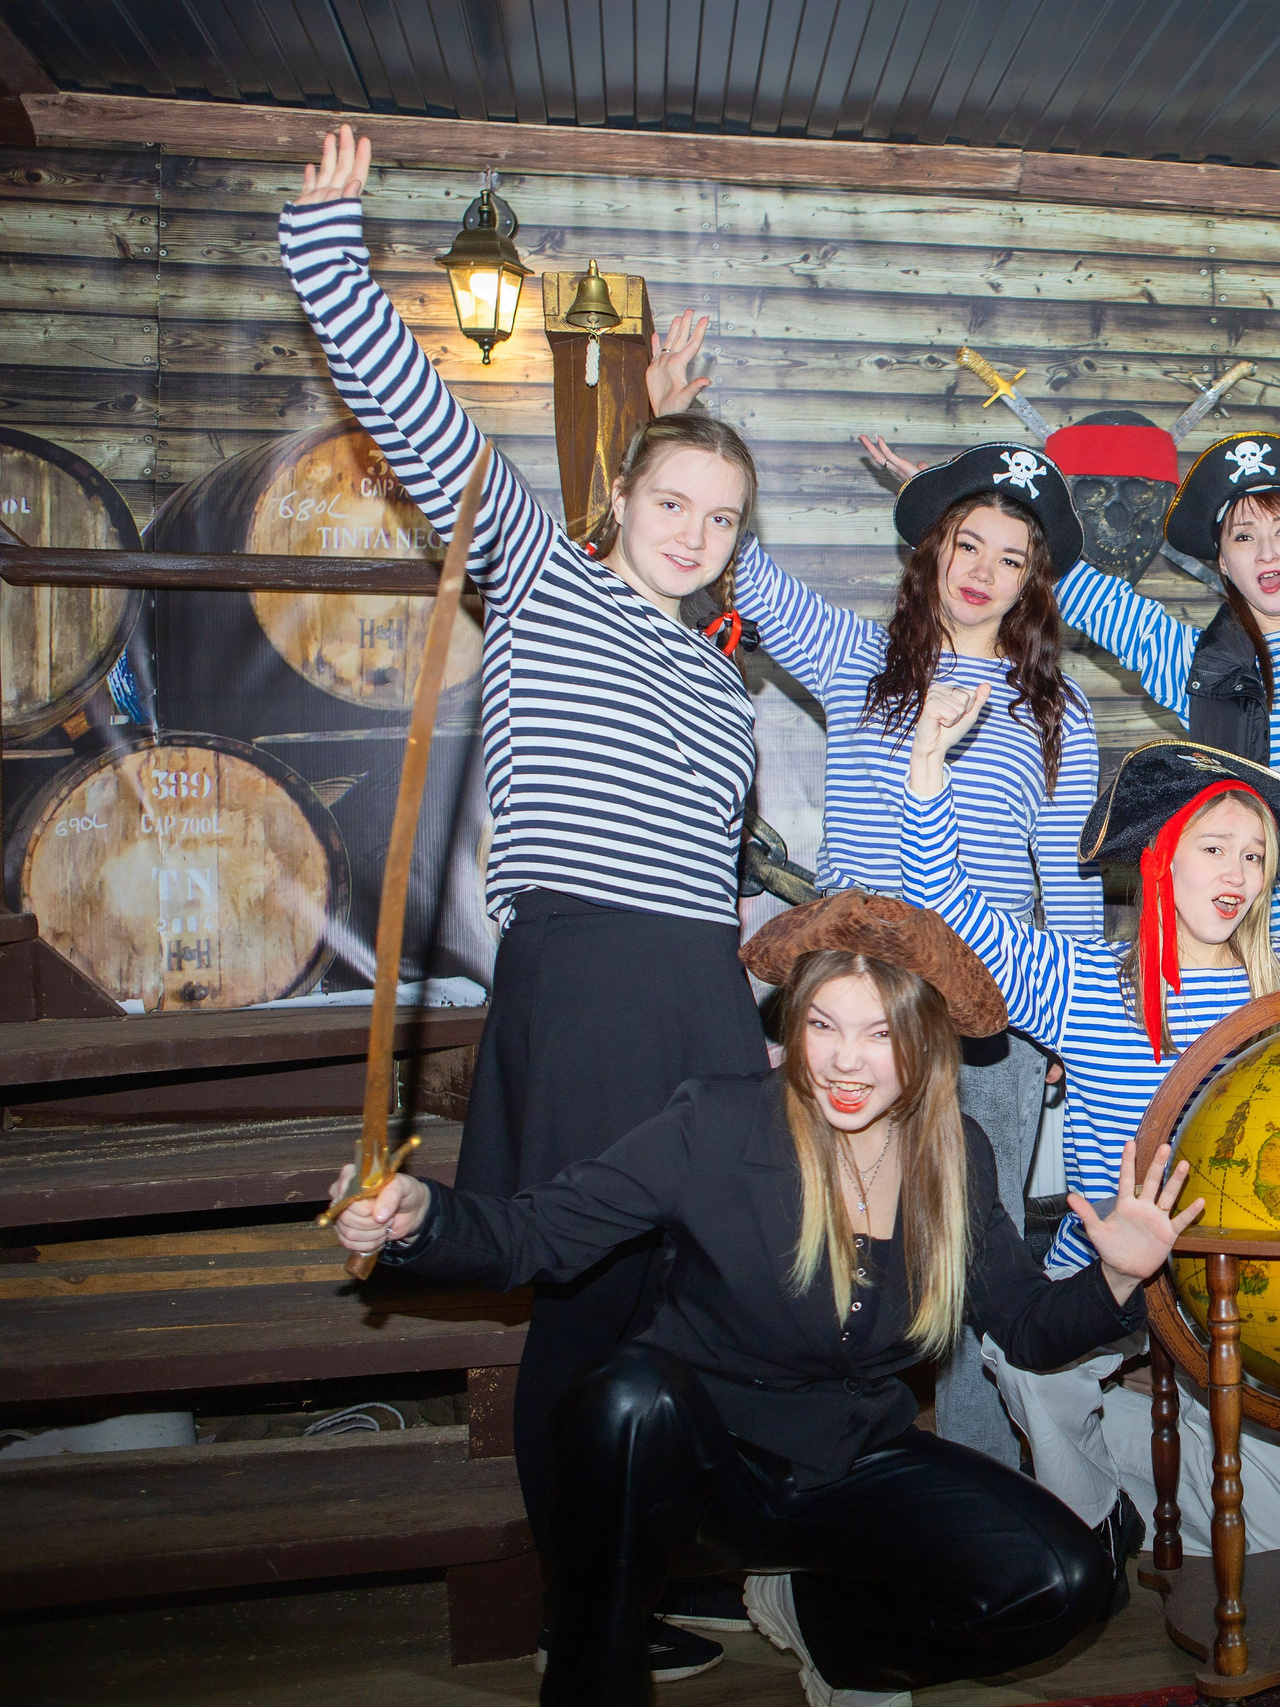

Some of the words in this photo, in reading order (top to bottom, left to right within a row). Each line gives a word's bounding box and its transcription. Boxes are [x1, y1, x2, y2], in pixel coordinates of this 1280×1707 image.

[361, 477, 394, 498] CAP
[316, 526, 390, 550] TINTA
[151, 769, 212, 800] 389
[178, 813, 224, 835] 700L
[166, 938, 212, 972] H&H
